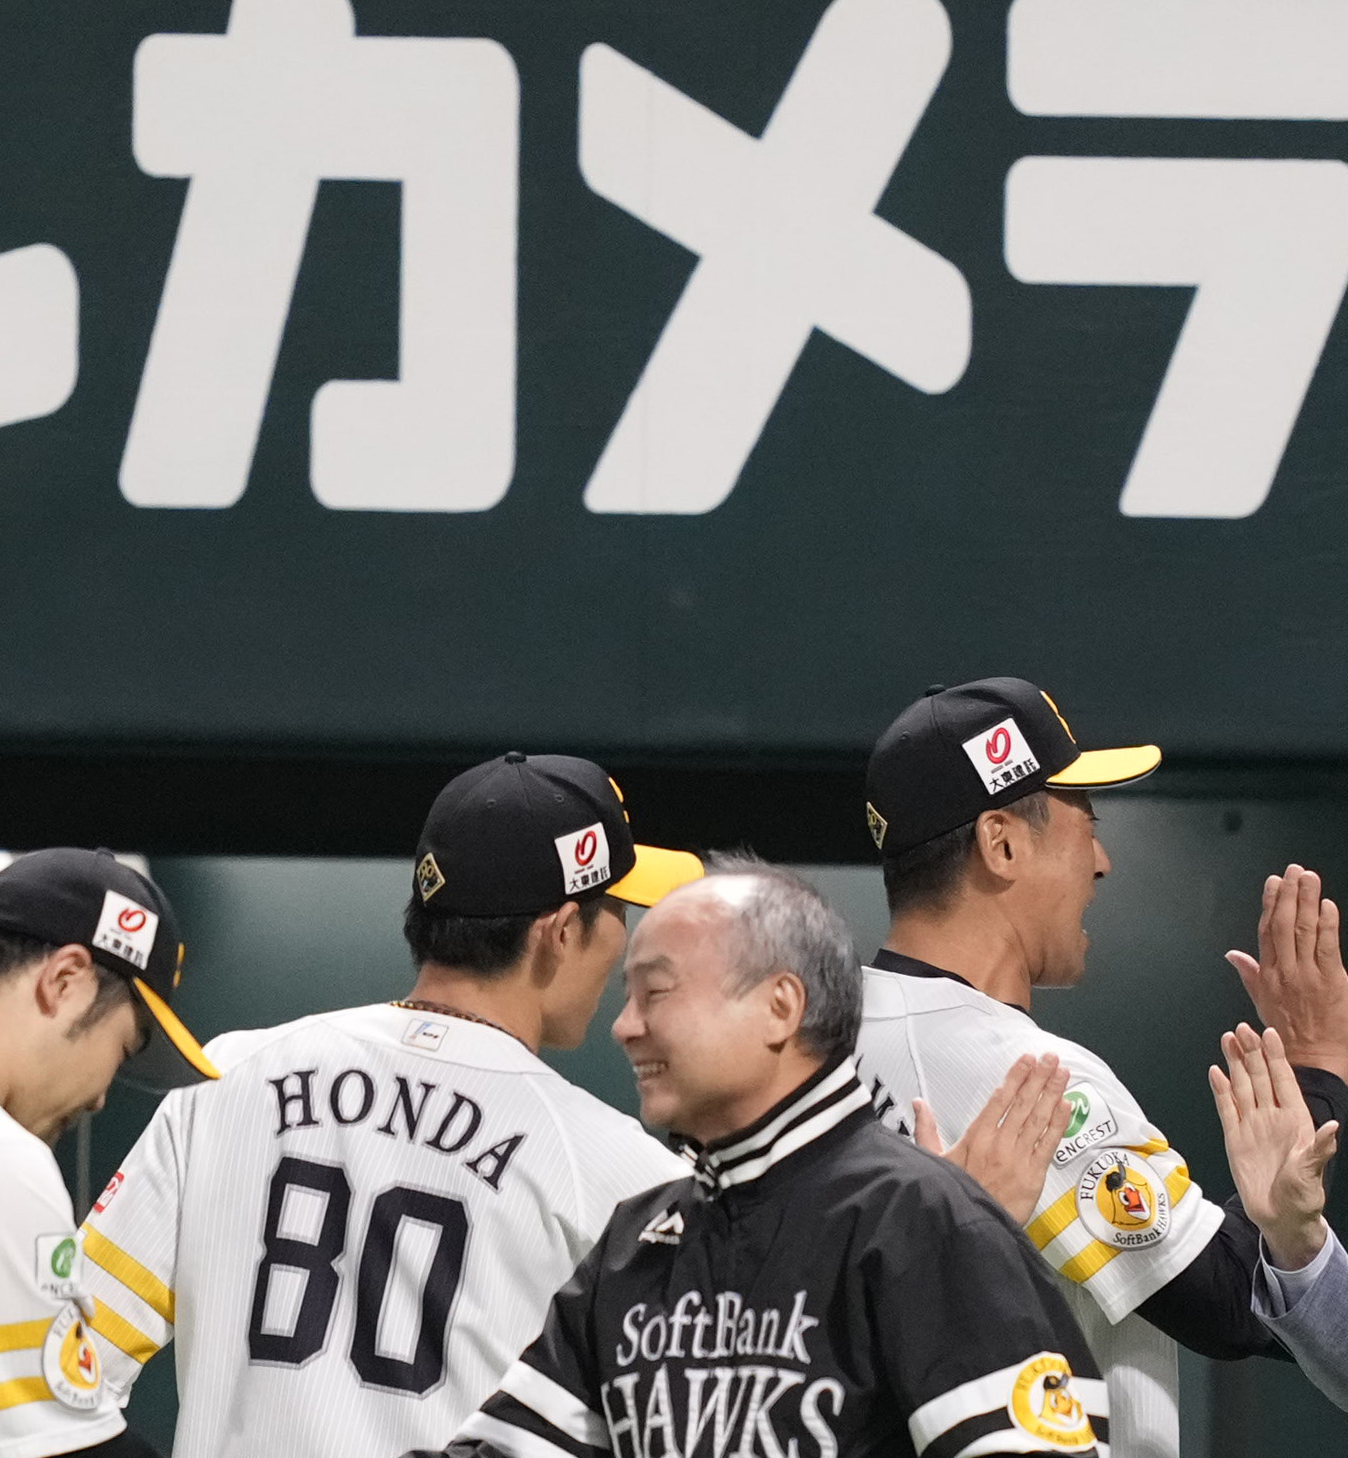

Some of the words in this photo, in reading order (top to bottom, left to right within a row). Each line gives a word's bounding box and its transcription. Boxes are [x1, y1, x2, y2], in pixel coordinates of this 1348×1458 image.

[269, 1066, 528, 1194] HONDA
[1080, 1151, 1131, 1201] FUKUOKA
[249, 1153, 474, 1399] 80
[1112, 1227, 1163, 1246] SoftBank
[616, 1288, 819, 1368] SoftBank
